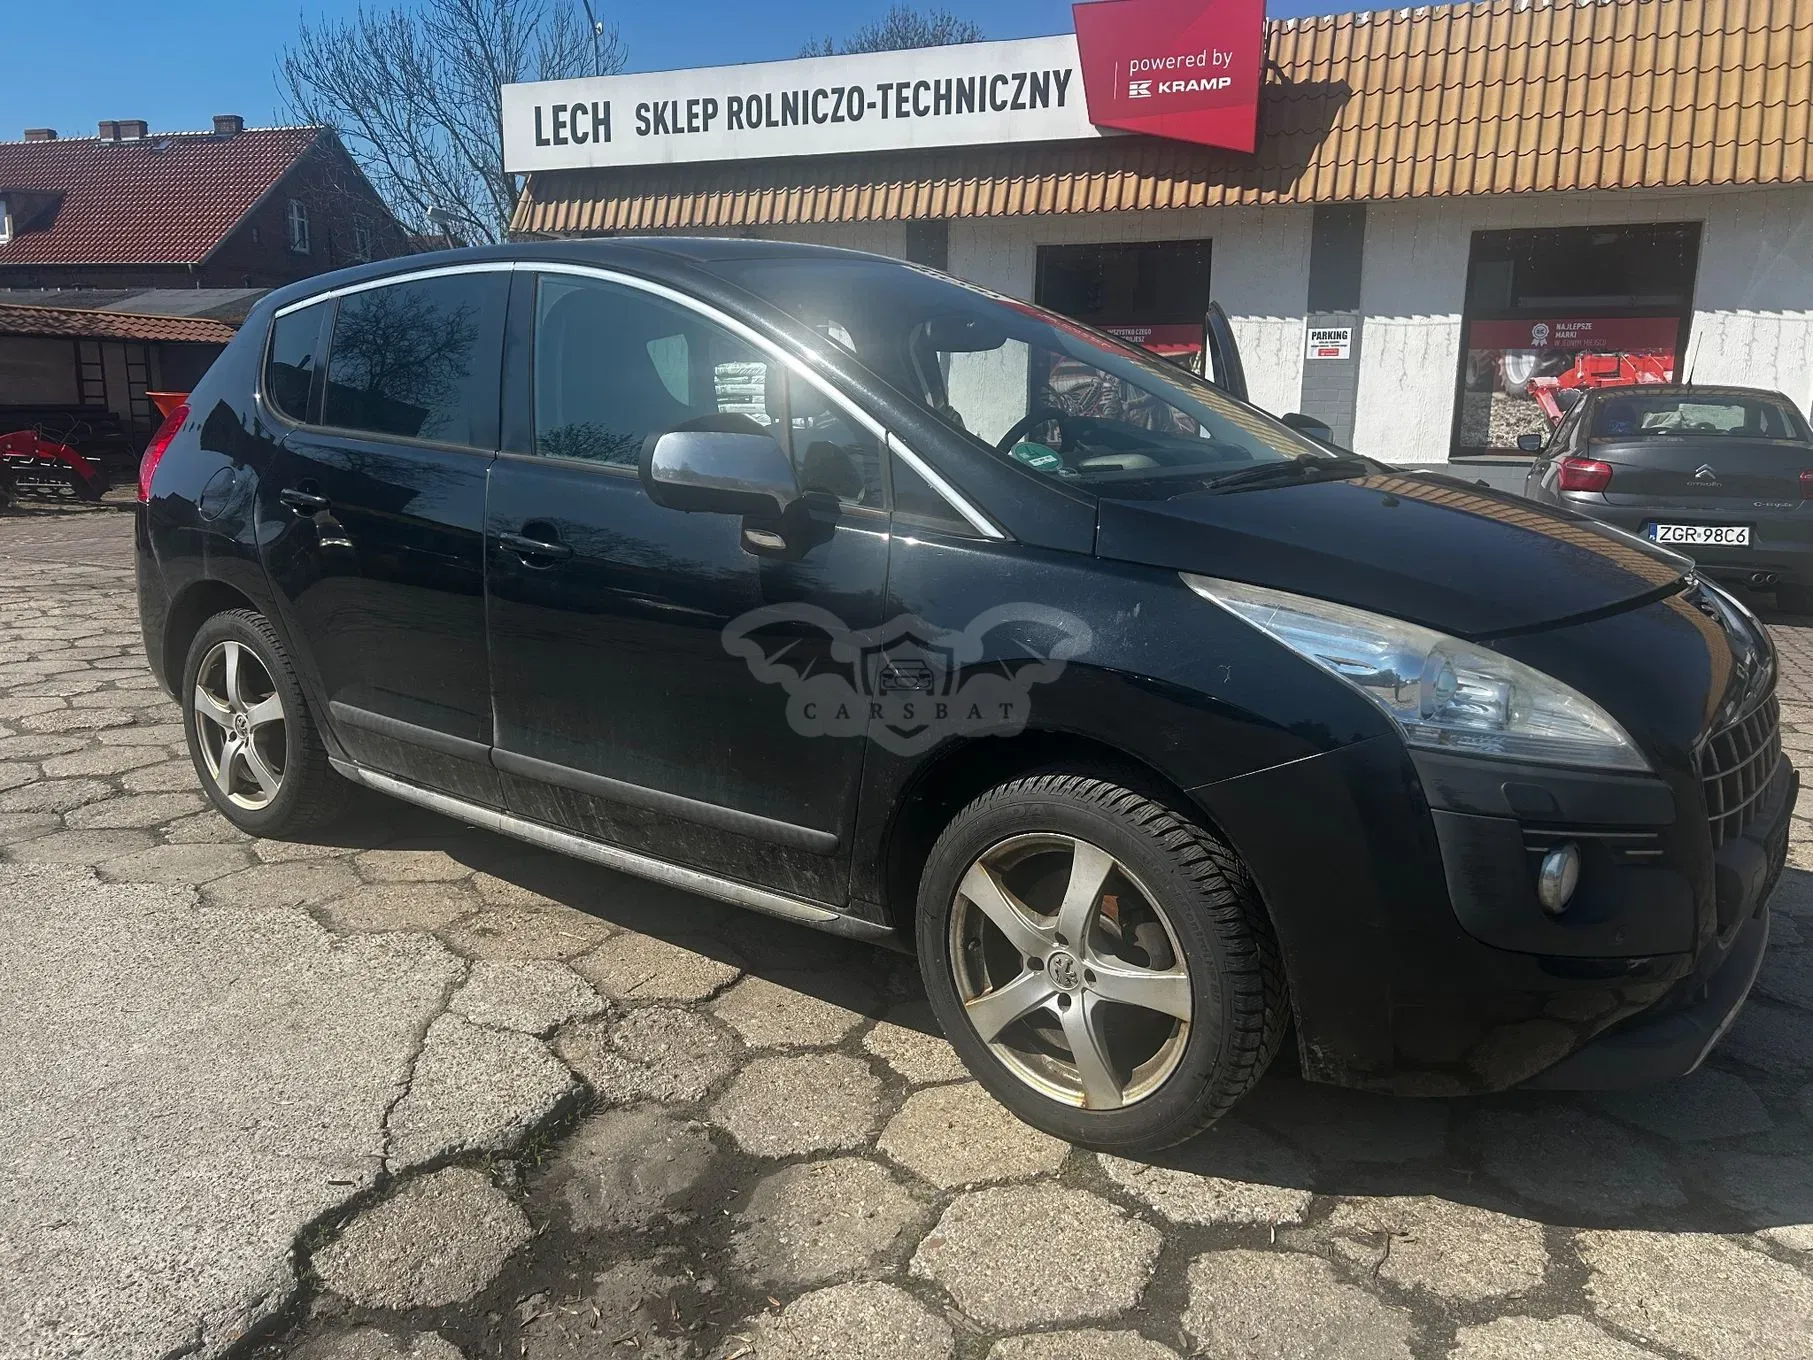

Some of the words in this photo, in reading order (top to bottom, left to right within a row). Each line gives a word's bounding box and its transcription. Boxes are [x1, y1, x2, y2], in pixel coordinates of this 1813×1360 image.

[1130, 50, 1206, 76] powered
[1213, 49, 1233, 68] by
[1158, 77, 1231, 93] KRAMP
[534, 101, 611, 146] LECH
[635, 97, 718, 136] SKLEP
[727, 69, 1072, 131] ROLNICZO-TECHNICZNY
[1556, 322, 1592, 330] NAJLEPSZE
[1311, 331, 1348, 340] PARKING
[1659, 527, 1697, 541] ZGR
[1703, 529, 1746, 543] 98C6
